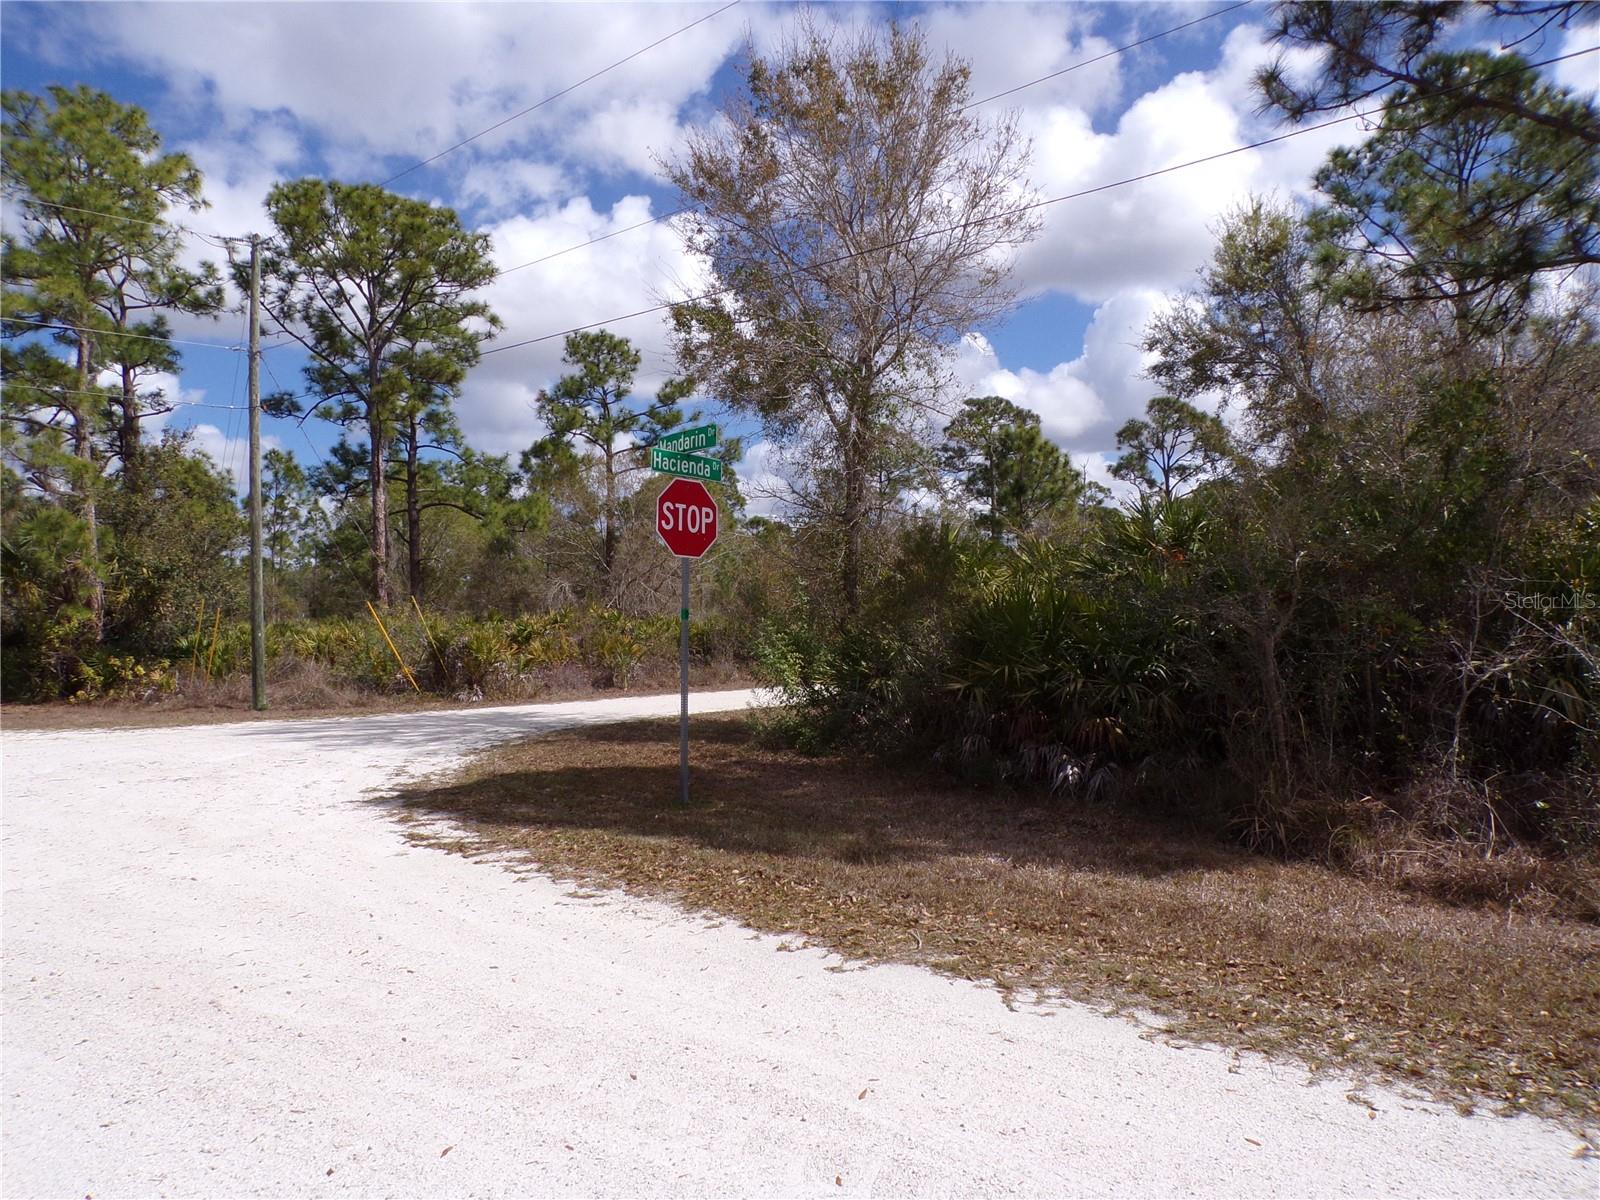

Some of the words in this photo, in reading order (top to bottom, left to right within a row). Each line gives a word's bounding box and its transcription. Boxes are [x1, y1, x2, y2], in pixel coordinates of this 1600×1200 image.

[659, 431, 706, 452] Mandarin
[707, 427, 716, 437] Dr
[653, 451, 711, 477] Hacienda
[712, 461, 720, 471] Dr
[661, 501, 714, 534] STOP
